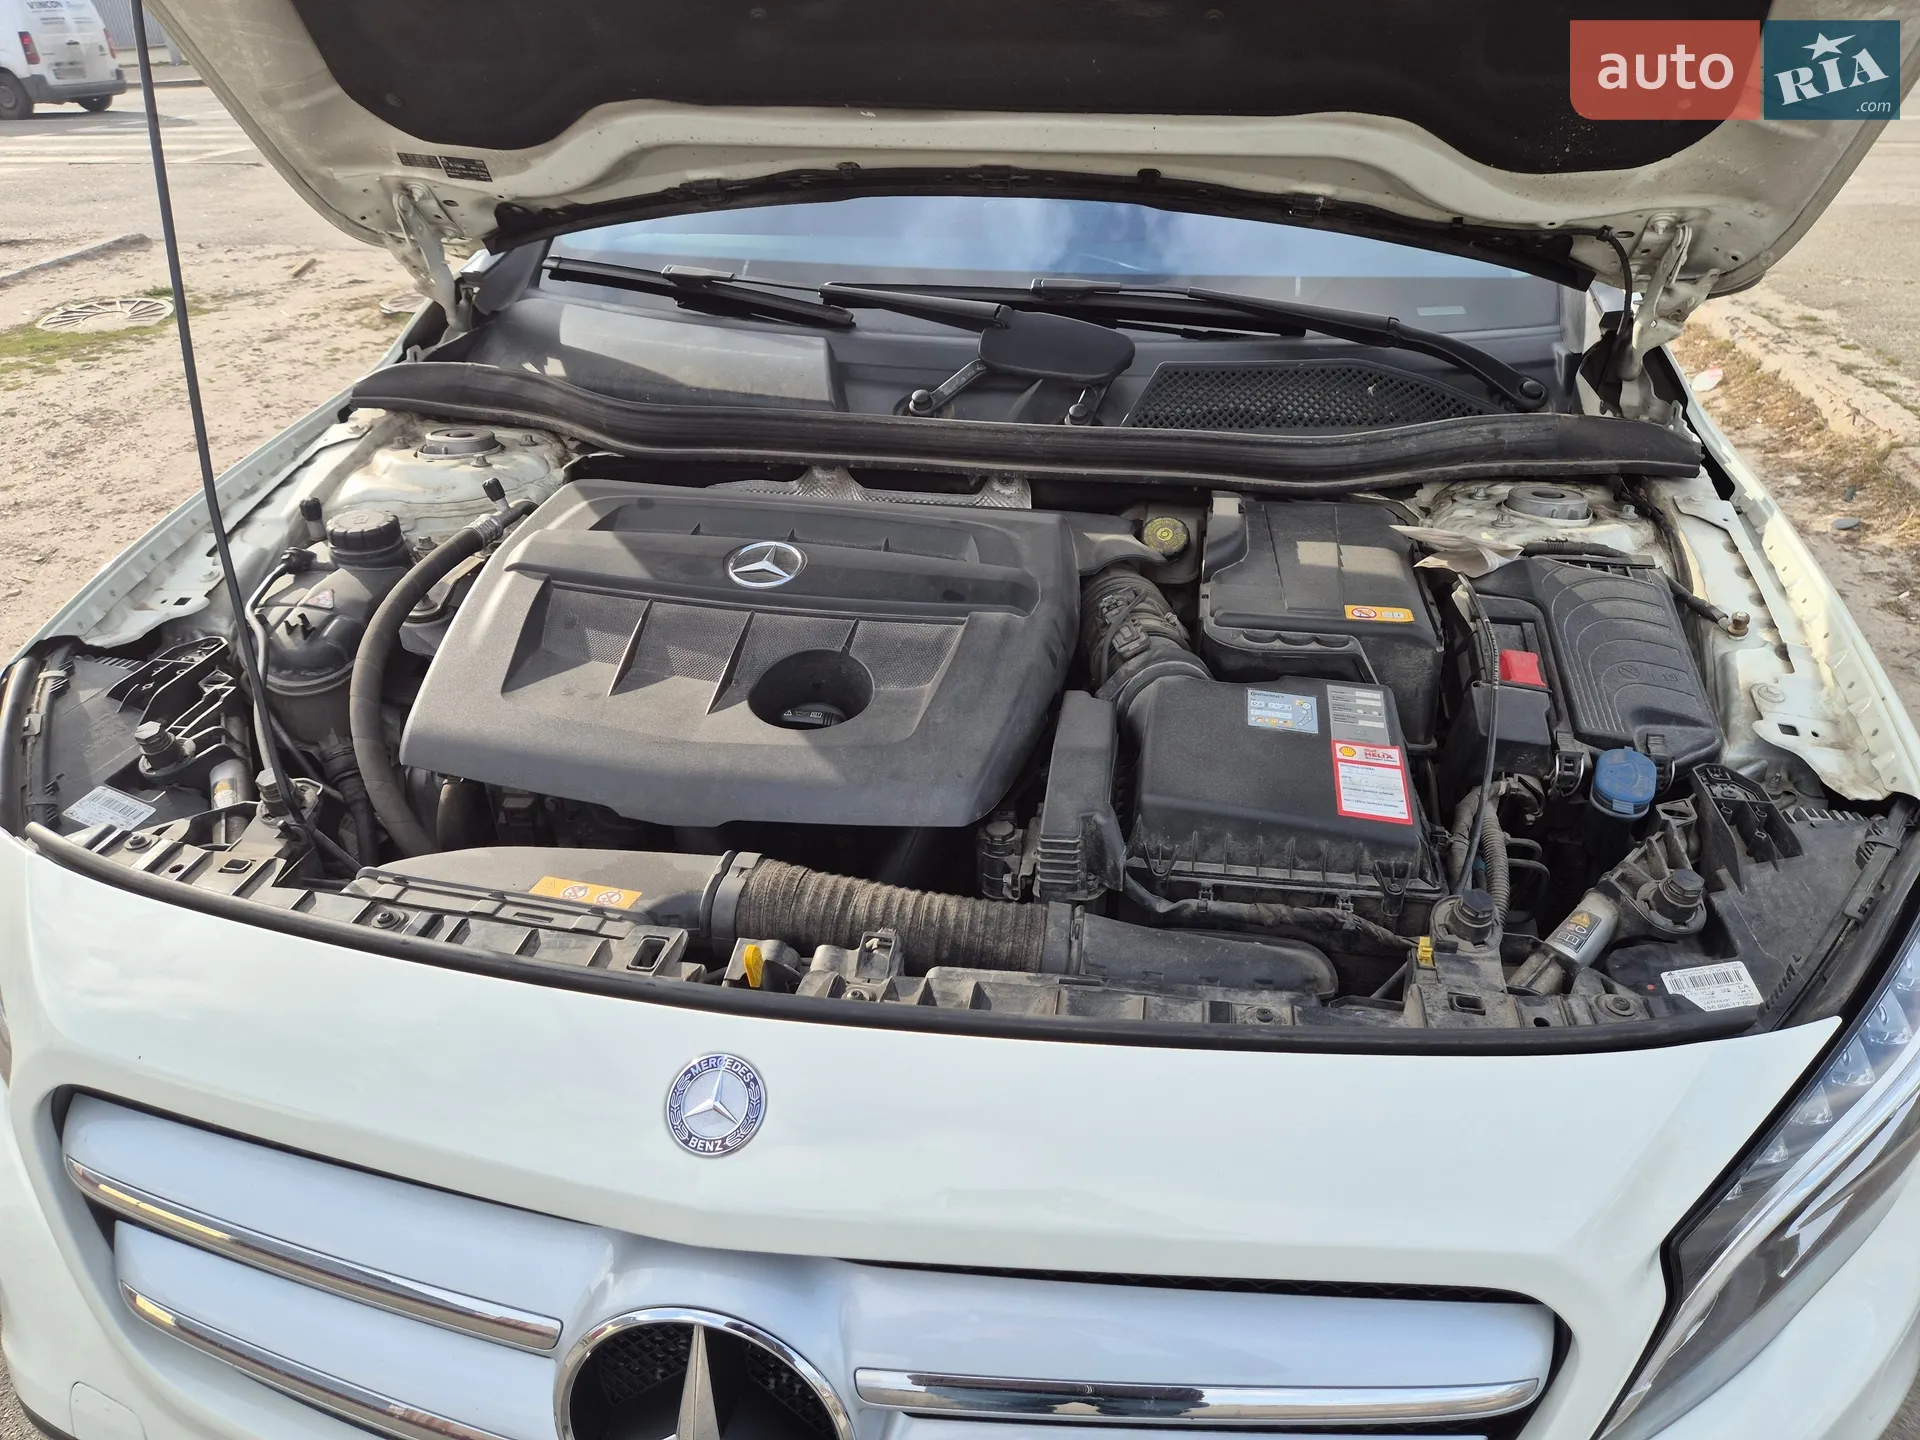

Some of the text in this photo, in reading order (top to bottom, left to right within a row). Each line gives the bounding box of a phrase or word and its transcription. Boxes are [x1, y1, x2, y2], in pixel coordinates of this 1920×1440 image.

[1364, 752, 1394, 760] HELIX
[689, 1057, 754, 1083] MERCEDES
[688, 1136, 724, 1152] BENZ
